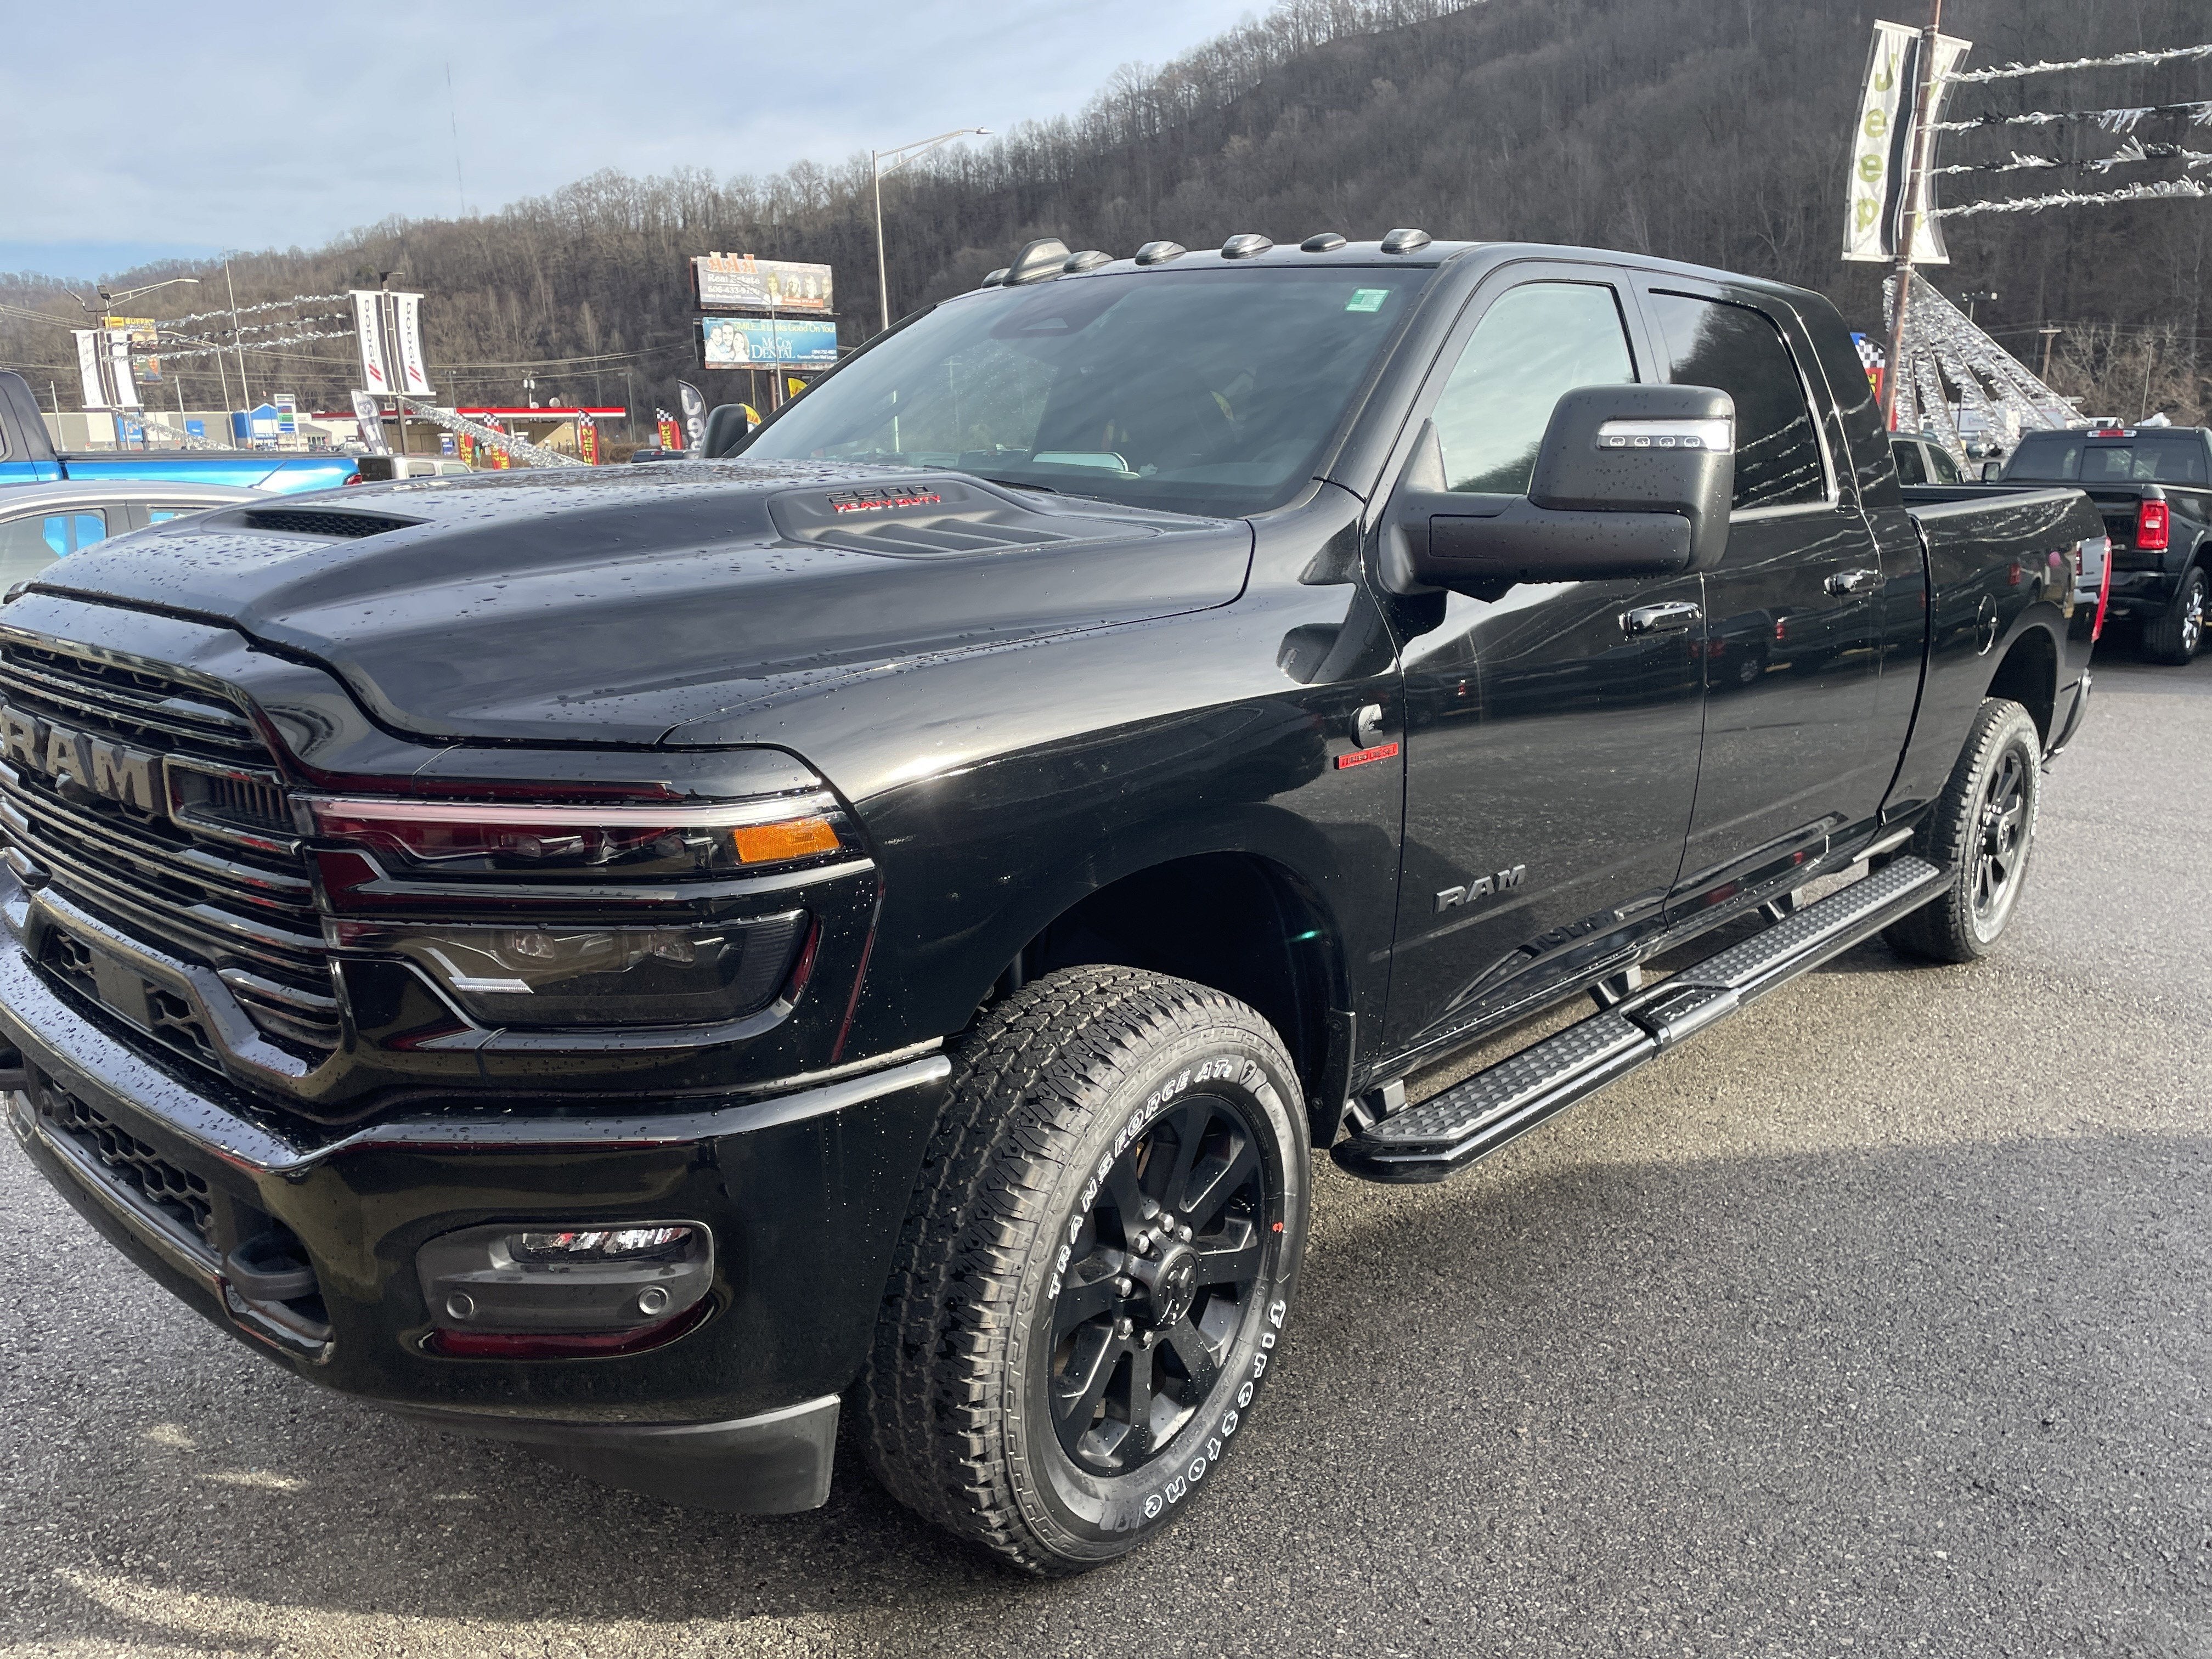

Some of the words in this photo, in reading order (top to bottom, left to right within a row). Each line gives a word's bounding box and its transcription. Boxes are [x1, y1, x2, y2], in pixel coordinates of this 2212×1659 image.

[1857, 53, 1897, 233] Jeep
[708, 274, 728, 282] Real
[730, 275, 760, 284] Estate
[788, 323, 808, 332] Good
[809, 324, 820, 332] On
[821, 324, 836, 333] You!
[751, 345, 795, 358] DENTAL
[834, 499, 894, 514] HEAVY
[894, 495, 941, 508] DUTY
[1359, 706, 1378, 732] Cummins
[1, 706, 167, 816] RAM
[1369, 746, 1397, 760] DIESEL
[1433, 864, 1526, 914] RAM
[1047, 1068, 1191, 1300] TRANSFORCE
